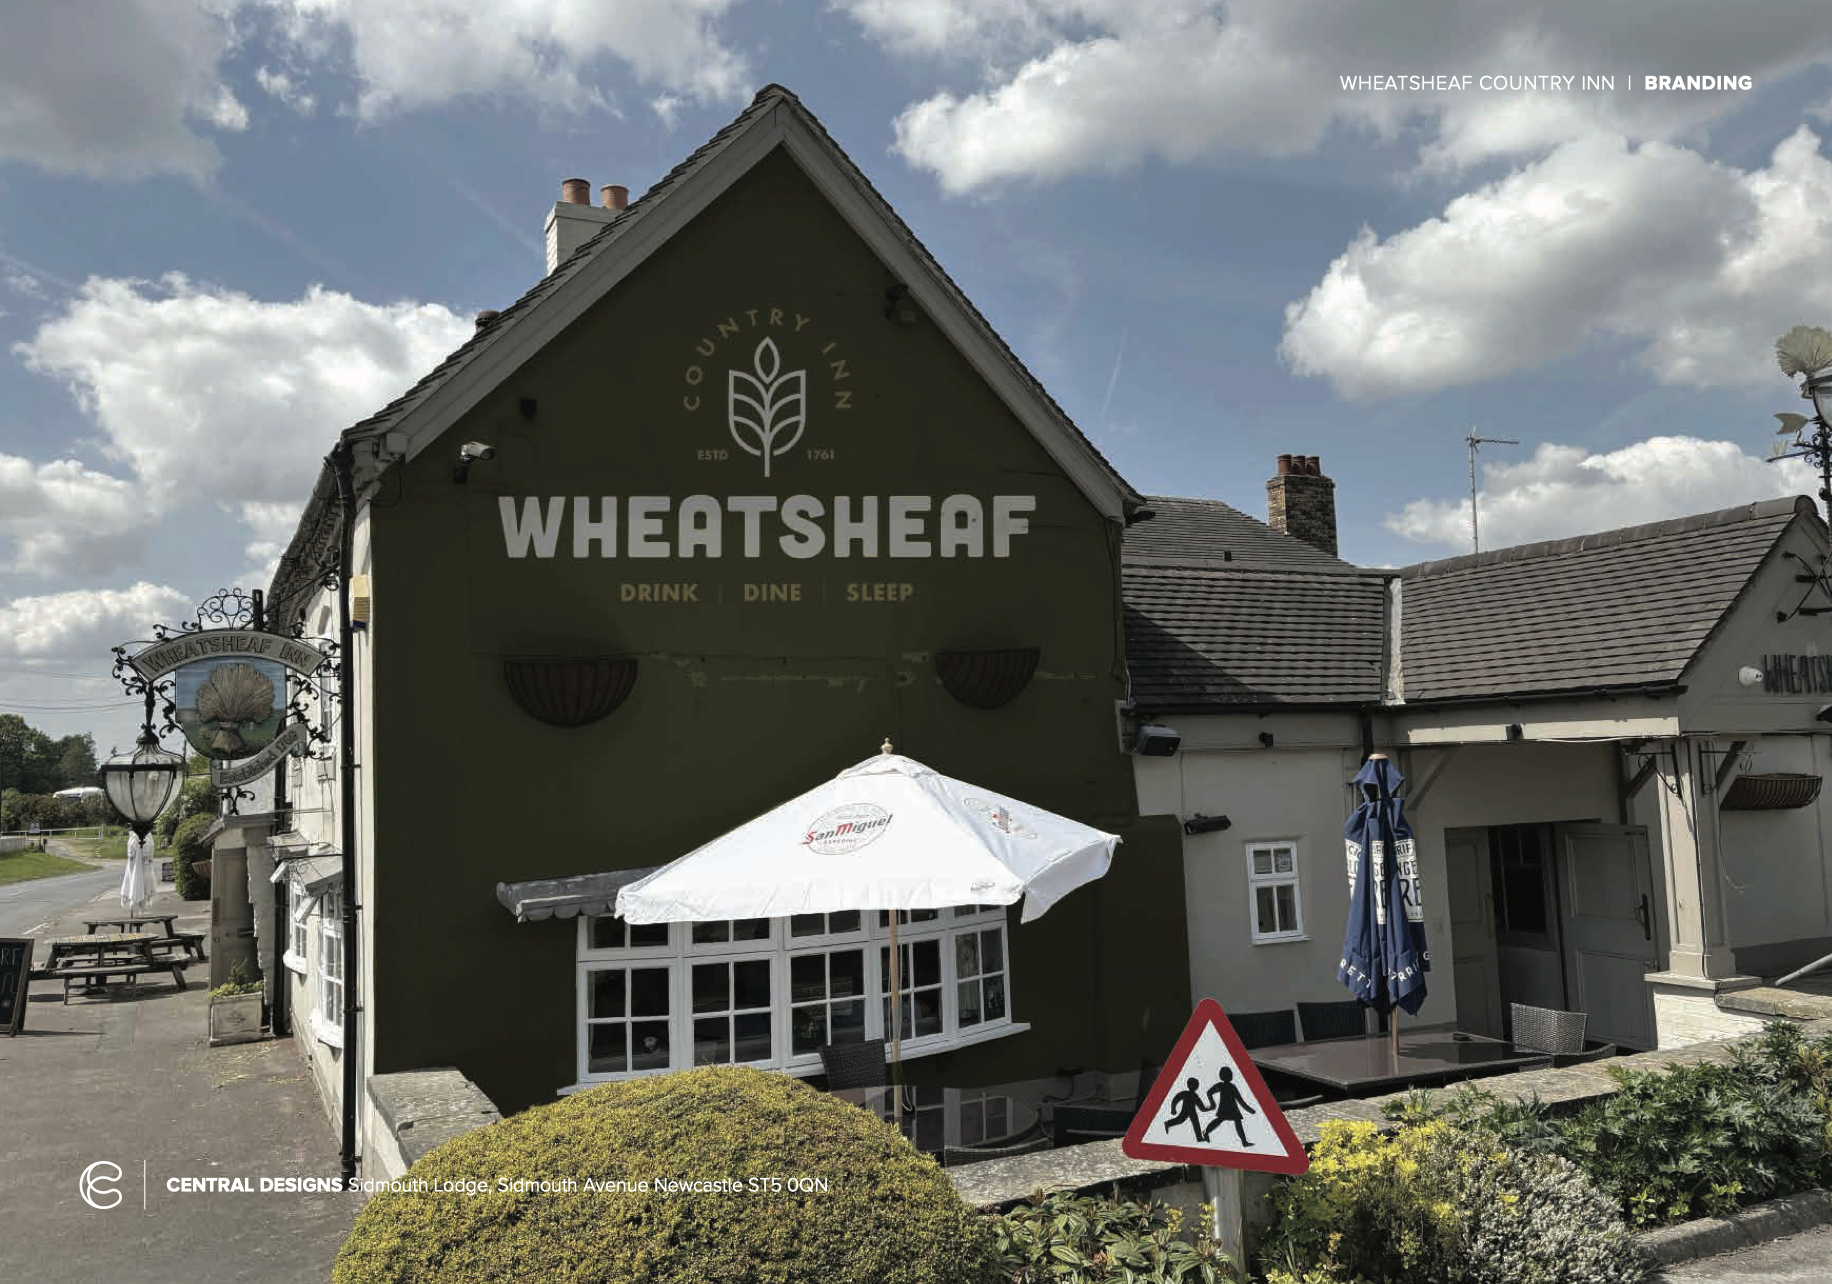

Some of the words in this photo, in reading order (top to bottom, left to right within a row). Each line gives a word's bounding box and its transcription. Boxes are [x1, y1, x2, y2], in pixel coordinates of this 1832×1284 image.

[684, 308, 811, 411] COUNTRY
[822, 342, 853, 409] INN
[698, 449, 729, 461] ESTD
[807, 449, 835, 461] 1761
[498, 494, 1036, 559] WHEATSHEAF
[620, 583, 699, 602] DRINK
[743, 583, 802, 602] DINE
[846, 583, 914, 602] SLEEP
[143, 635, 272, 673] WHEATSHEAF
[278, 642, 313, 668] INN
